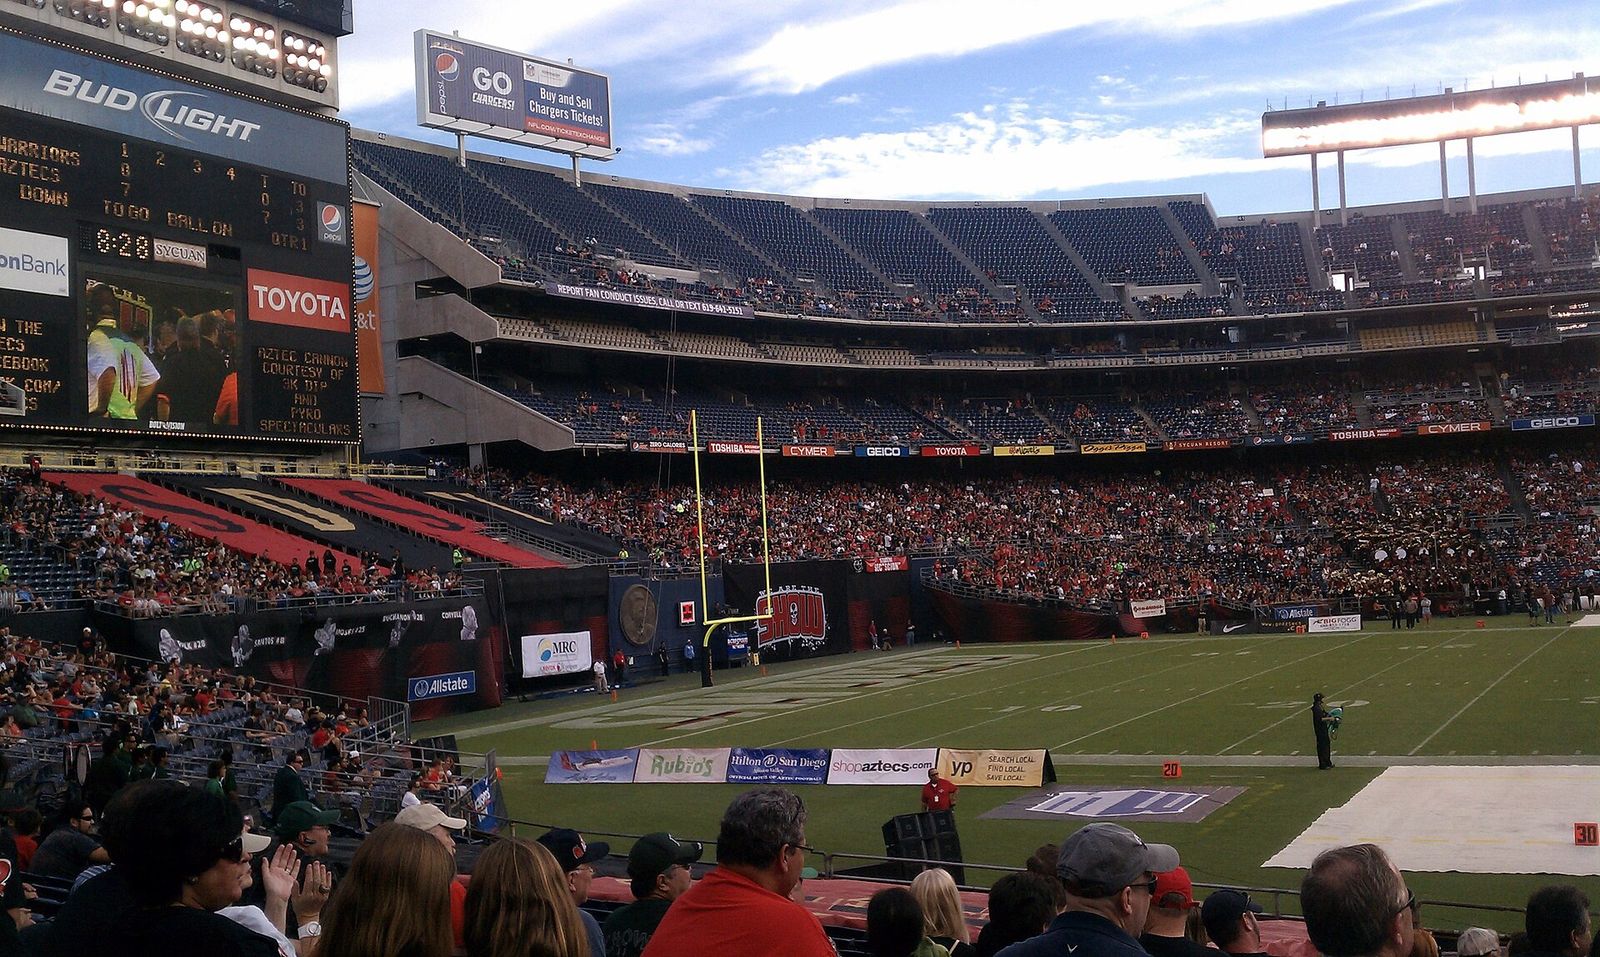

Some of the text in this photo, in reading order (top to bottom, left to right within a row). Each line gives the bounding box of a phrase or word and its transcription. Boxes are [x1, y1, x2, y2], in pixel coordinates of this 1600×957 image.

[472, 66, 512, 95] GO
[438, 80, 447, 114] pepsi
[472, 92, 515, 110] CHARGERS!
[540, 87, 592, 110] Buy and Sell
[43, 69, 261, 142] BUD LIGHT
[529, 100, 603, 127] Chargers Tickets!
[121, 142, 129, 158] 1
[156, 150, 165, 166] 2
[193, 159, 201, 175] 3
[227, 167, 236, 180] 4
[19, 183, 68, 207] DOWN
[323, 233, 342, 243] pepsi
[155, 244, 206, 263] SYCUAN
[253, 284, 346, 320] TOYOTA
[557, 284, 584, 296] REPORT
[584, 288, 600, 299] FAN
[600, 290, 633, 302] CONDUCT
[633, 294, 658, 306] ISSUES,
[658, 297, 675, 308] CALL
[675, 299, 685, 309] OR
[684, 300, 701, 311] TEXT
[15, 319, 43, 336] THE
[258, 347, 297, 362] AZTEC
[262, 361, 344, 380] COURTESY OF
[294, 393, 317, 406] AND
[290, 406, 321, 421] PYRO
[259, 420, 351, 436] SPECTACULARS
[1428, 422, 1481, 434] CYMER
[1530, 416, 1579, 428] GEICO
[1332, 430, 1375, 440] TOSHIBA
[711, 443, 744, 453] TOSHIBA
[790, 446, 828, 456] CYMER
[866, 446, 900, 456] GEICO
[935, 447, 967, 455] TOYOTA
[1289, 607, 1313, 618] Allstate
[553, 641, 577, 654] MRC
[429, 676, 468, 694] Allstate
[651, 754, 714, 777] Rubio's
[731, 755, 826, 771] Hilton San Diego
[988, 755, 1015, 763] SEARCH
[832, 760, 932, 775] shopaztecs.com
[951, 760, 973, 777] yp
[1164, 763, 1178, 777] 20
[1576, 825, 1597, 844] 30
